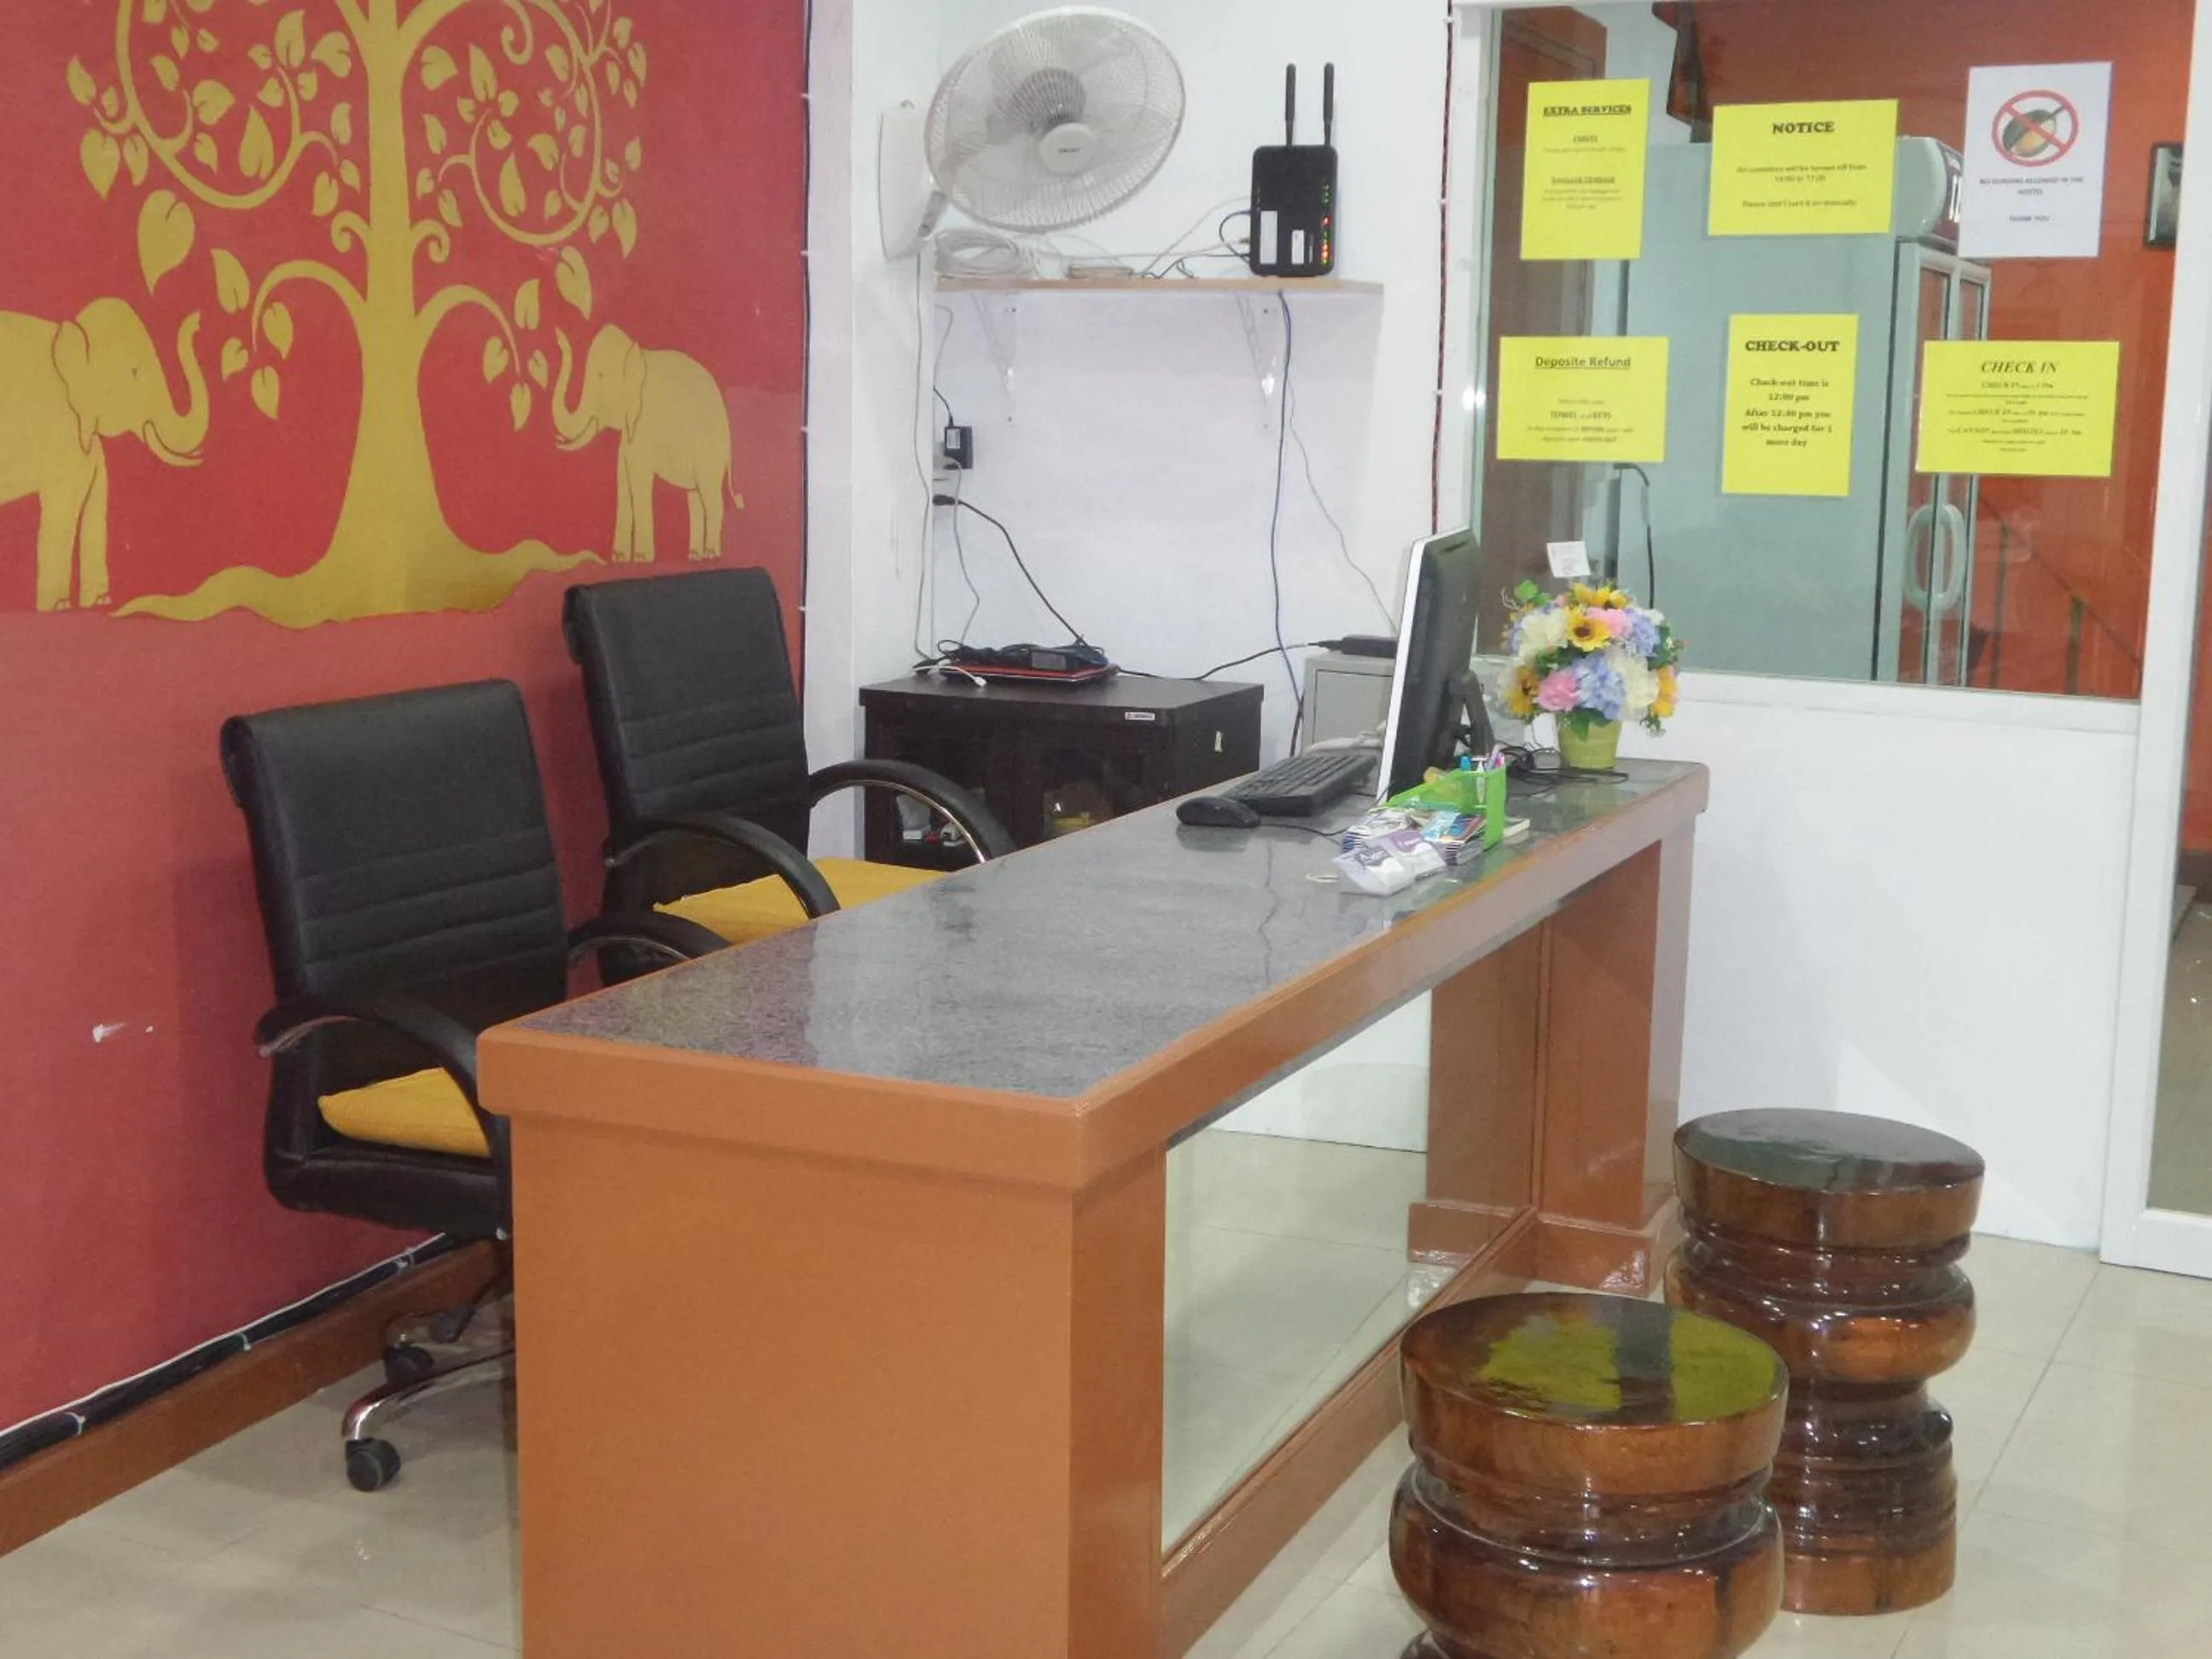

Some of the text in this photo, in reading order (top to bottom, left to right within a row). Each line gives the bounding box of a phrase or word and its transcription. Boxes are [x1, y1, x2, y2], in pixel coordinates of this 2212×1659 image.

[1543, 104, 1632, 117] EXTRA SERVICES
[1773, 121, 1835, 134] NOTICE
[1745, 341, 1840, 352] CHECK-OUT
[1534, 356, 1631, 370] Deposite Refund
[1981, 360, 2059, 374] CHECK IN
[1798, 378, 1819, 387] time
[1745, 409, 1768, 417] After
[1741, 422, 1758, 431] will
[1761, 422, 1771, 432] be
[1773, 423, 1809, 434] charged
[1790, 438, 1807, 448] day
